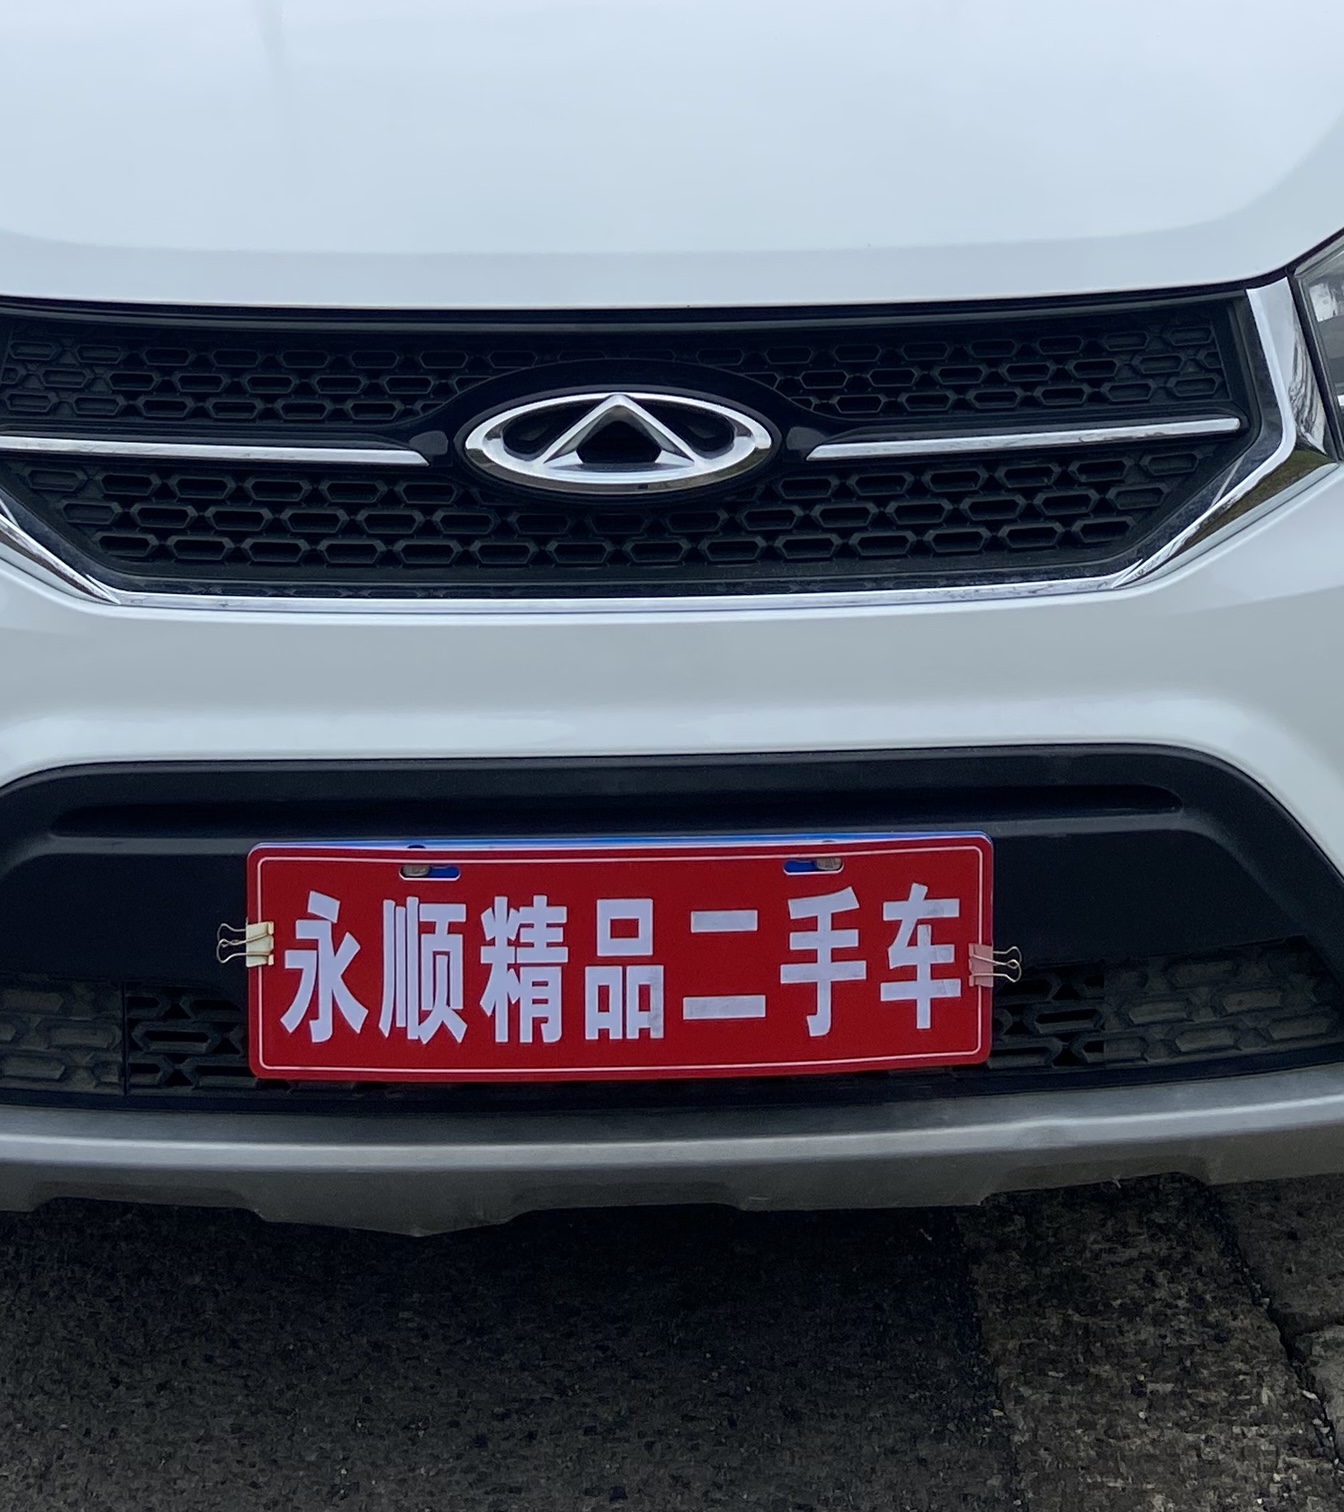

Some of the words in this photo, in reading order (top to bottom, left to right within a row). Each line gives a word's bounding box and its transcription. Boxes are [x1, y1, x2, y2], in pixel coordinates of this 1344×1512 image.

[280, 882, 963, 1045] 永顺精品二手车
